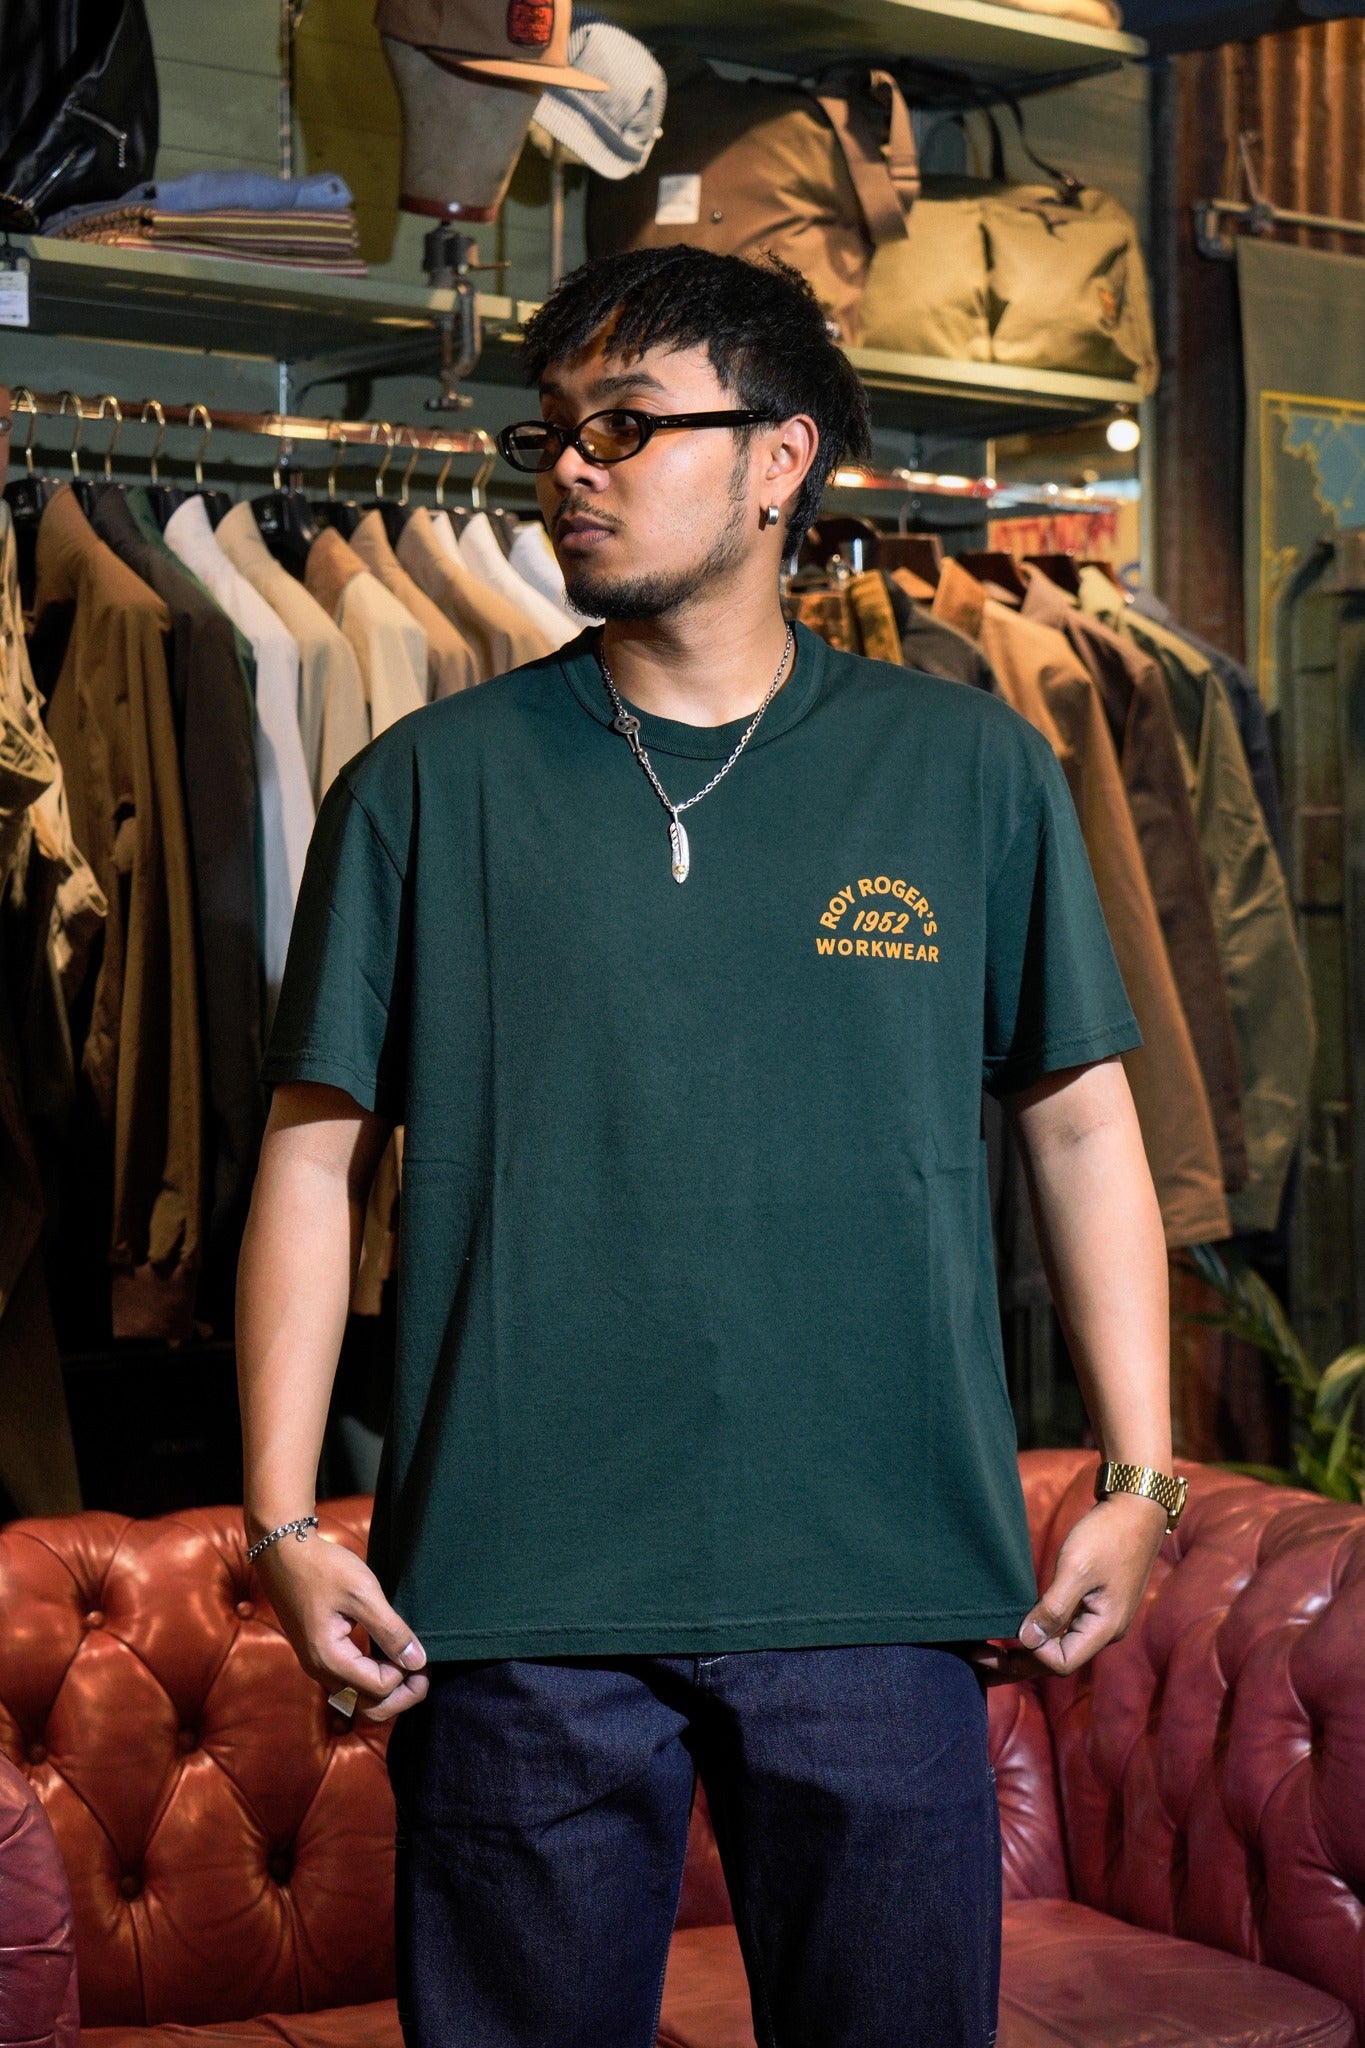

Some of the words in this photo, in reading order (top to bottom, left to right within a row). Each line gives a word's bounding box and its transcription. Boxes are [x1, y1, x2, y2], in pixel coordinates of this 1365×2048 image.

[819, 885, 856, 930] ROY
[857, 876, 938, 937] ROGER'S
[852, 910, 910, 934] 1952
[816, 937, 939, 963] WORKWEAR
